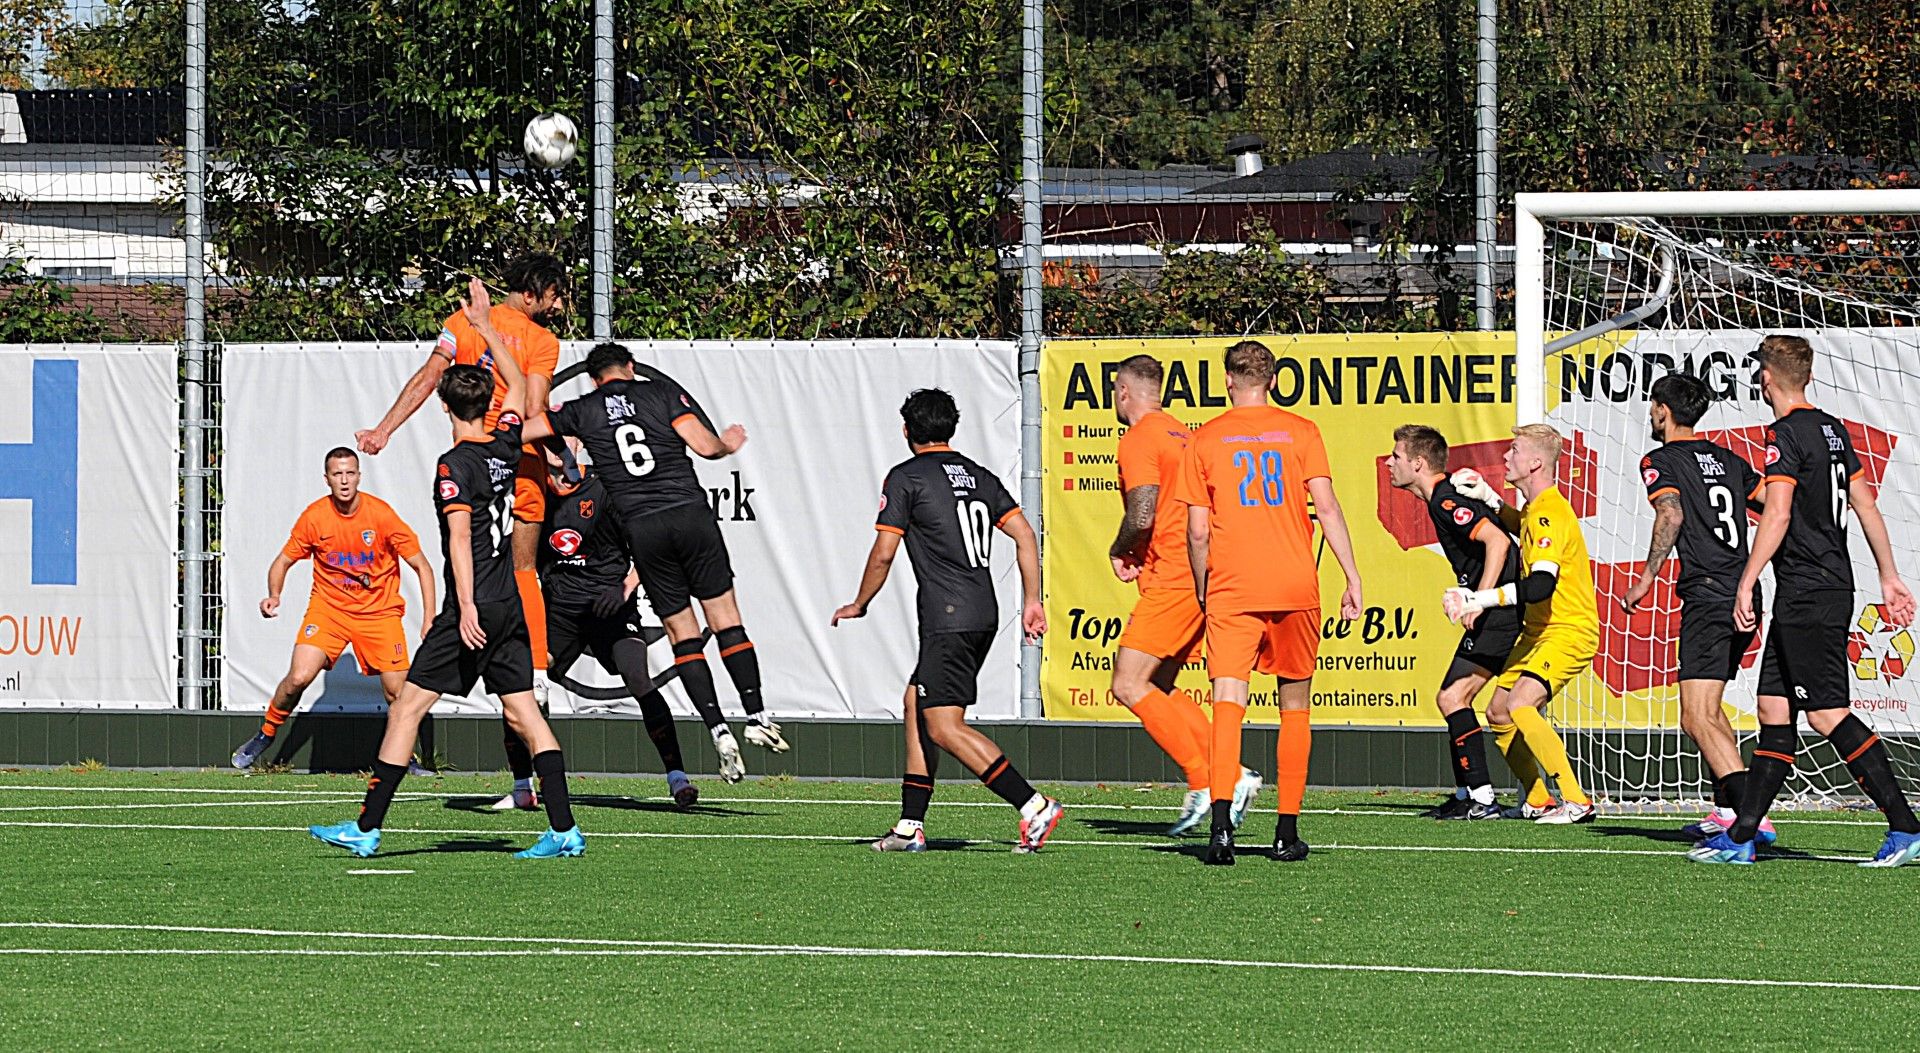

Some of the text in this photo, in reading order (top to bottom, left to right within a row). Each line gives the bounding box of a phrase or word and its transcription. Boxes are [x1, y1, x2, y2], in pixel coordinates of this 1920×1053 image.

[615, 424, 656, 477] 6
[1078, 425, 1113, 438] Huur
[1233, 450, 1284, 507] 28
[956, 500, 990, 568] 10
[1708, 485, 1739, 549] 3
[1068, 608, 1122, 648] Top
[1361, 606, 1418, 645] B.V.
[1069, 688, 1099, 707] Tel.
